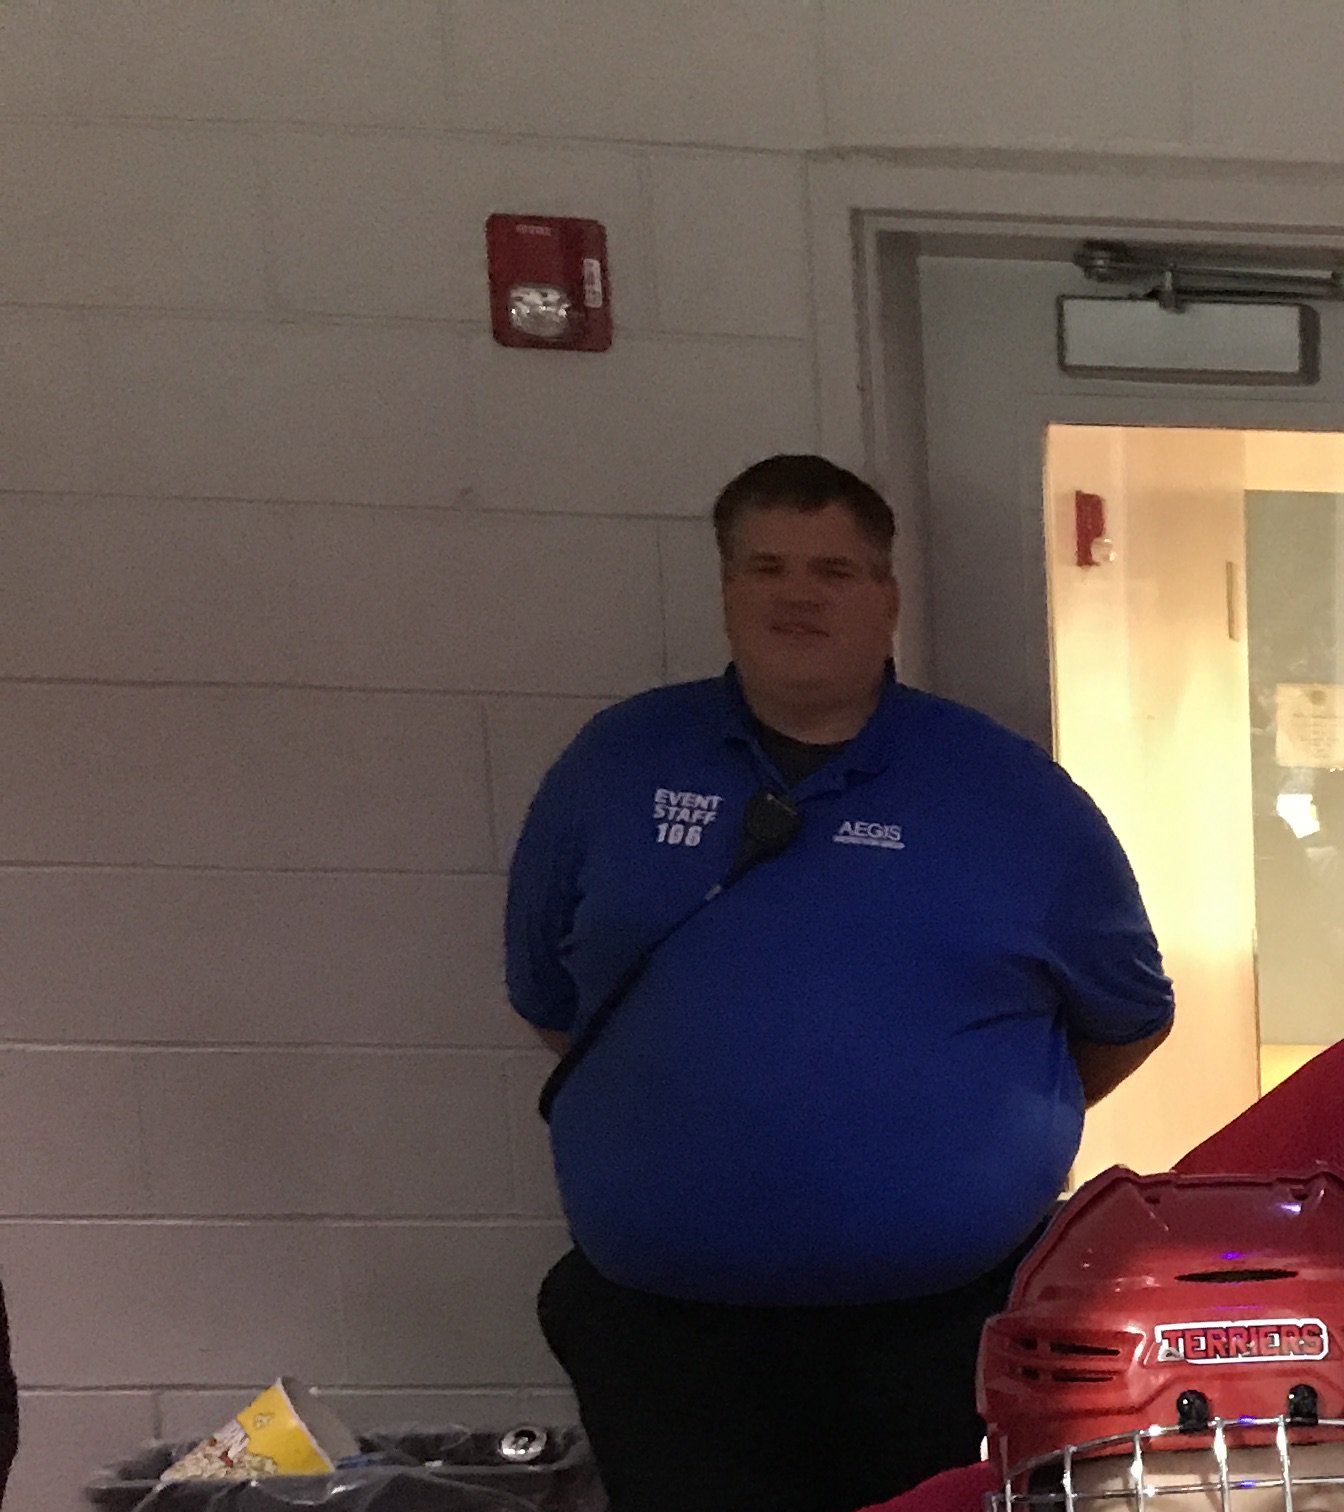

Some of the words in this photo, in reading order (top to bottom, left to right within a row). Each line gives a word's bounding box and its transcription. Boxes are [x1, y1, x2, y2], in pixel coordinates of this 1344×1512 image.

[654, 788, 722, 810] EVENT
[653, 804, 717, 825] STAFF
[838, 821, 902, 842] AEGIS
[1161, 1322, 1324, 1360] TERRIERS
